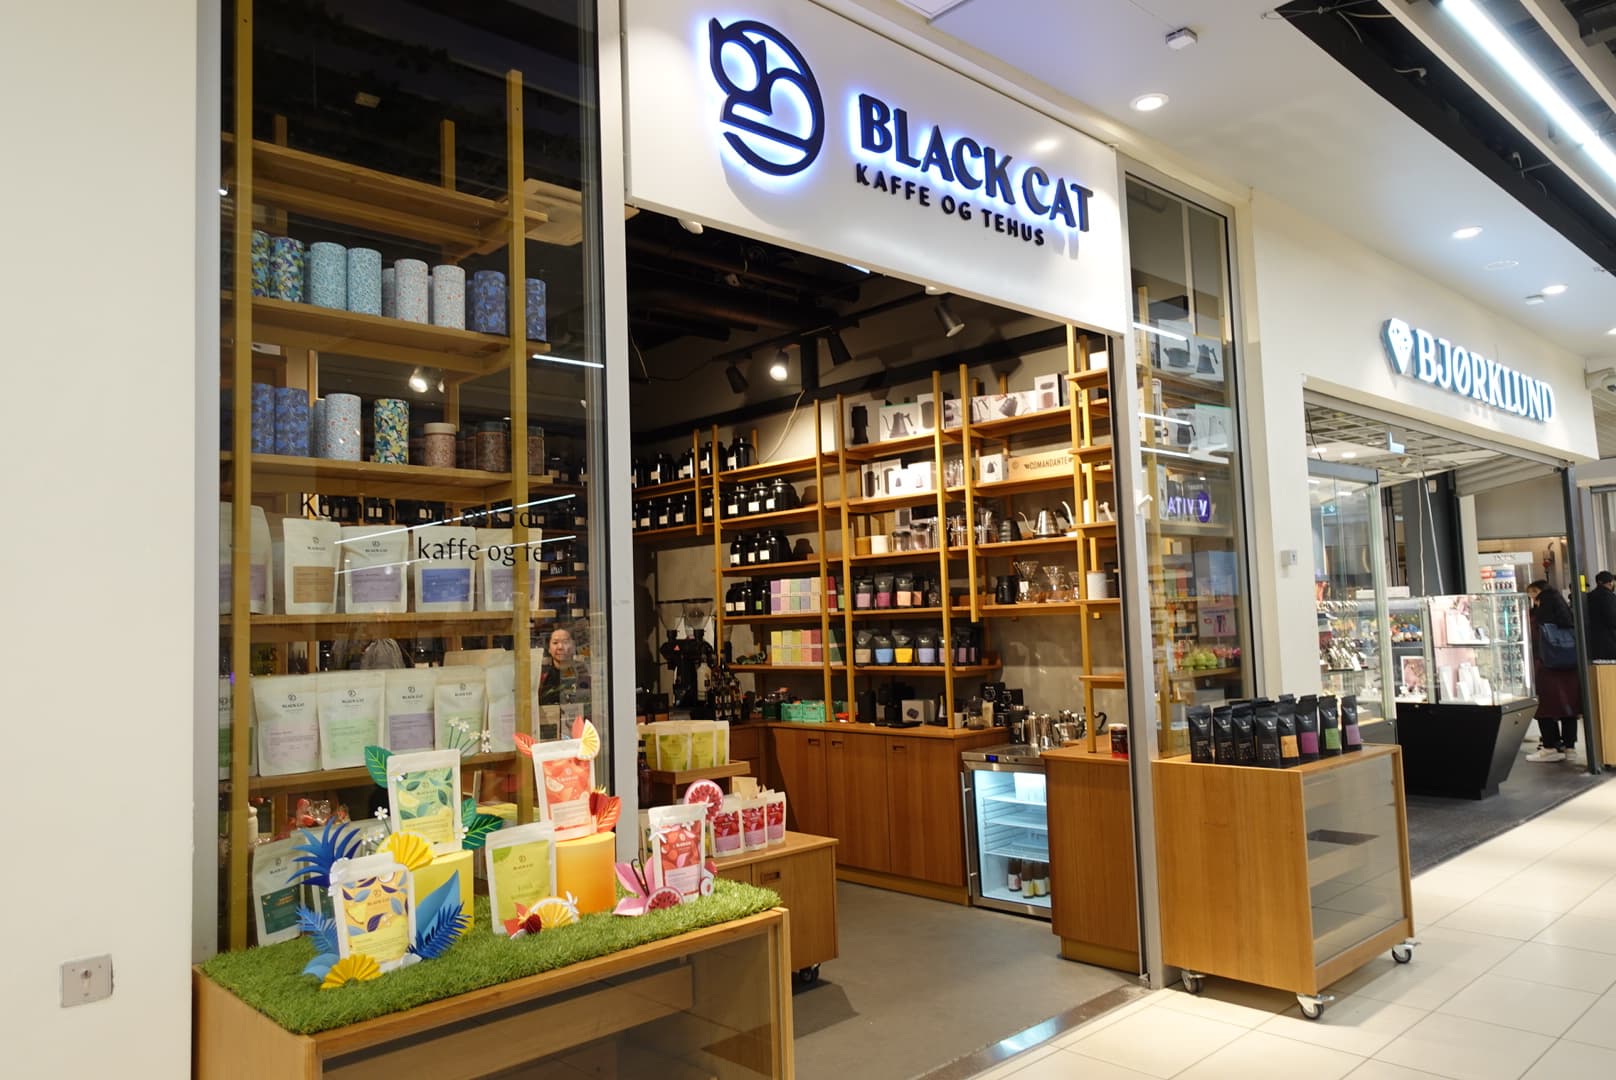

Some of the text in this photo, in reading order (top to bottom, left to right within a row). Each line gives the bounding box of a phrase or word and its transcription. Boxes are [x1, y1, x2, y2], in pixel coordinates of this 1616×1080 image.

[856, 163, 1045, 246] KAFFE OG TEHUS
[858, 93, 1094, 232] BLACK CAT
[1413, 328, 1556, 423] BJØRKLUND
[418, 536, 480, 560] kaffe
[488, 545, 515, 566] og
